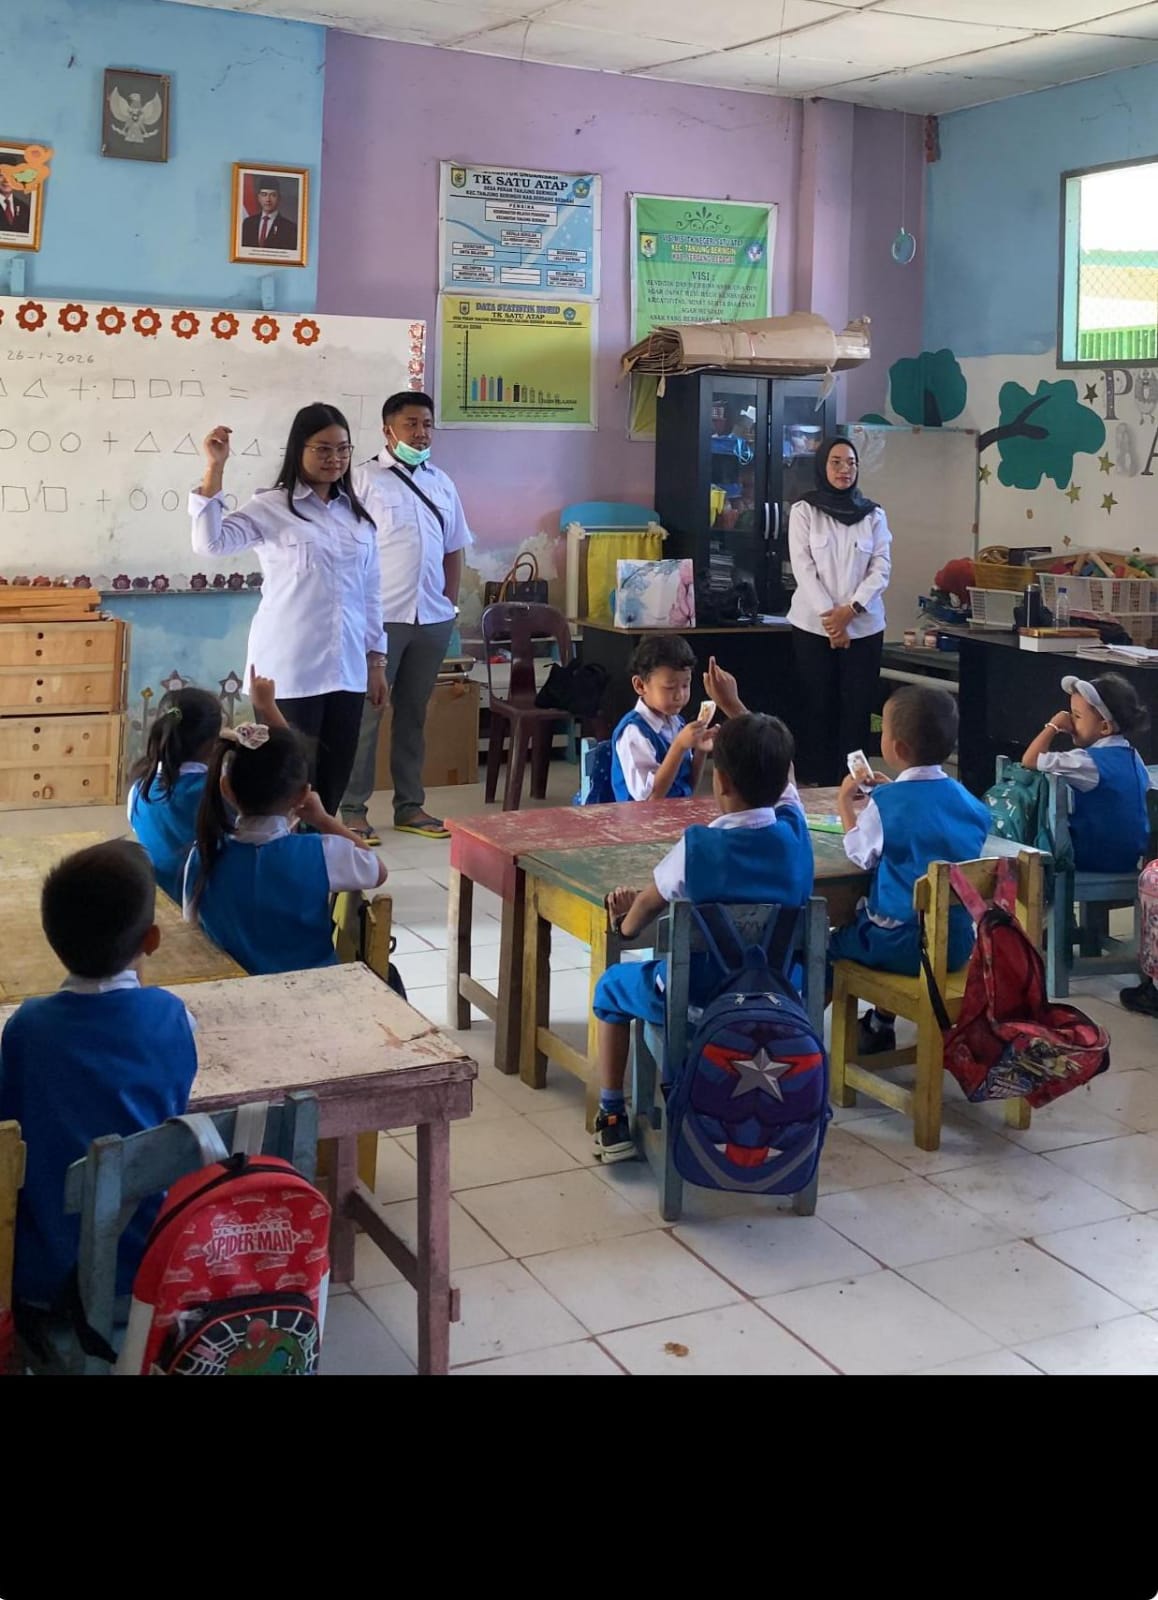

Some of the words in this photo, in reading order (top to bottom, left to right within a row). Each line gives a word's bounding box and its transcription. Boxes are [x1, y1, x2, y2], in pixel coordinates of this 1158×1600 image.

[473, 174, 492, 185] TK
[496, 176, 531, 189] SATU
[534, 179, 569, 191] ATAP
[691, 271, 710, 281] VISI
[213, 1221, 291, 1237] ULTIMATE
